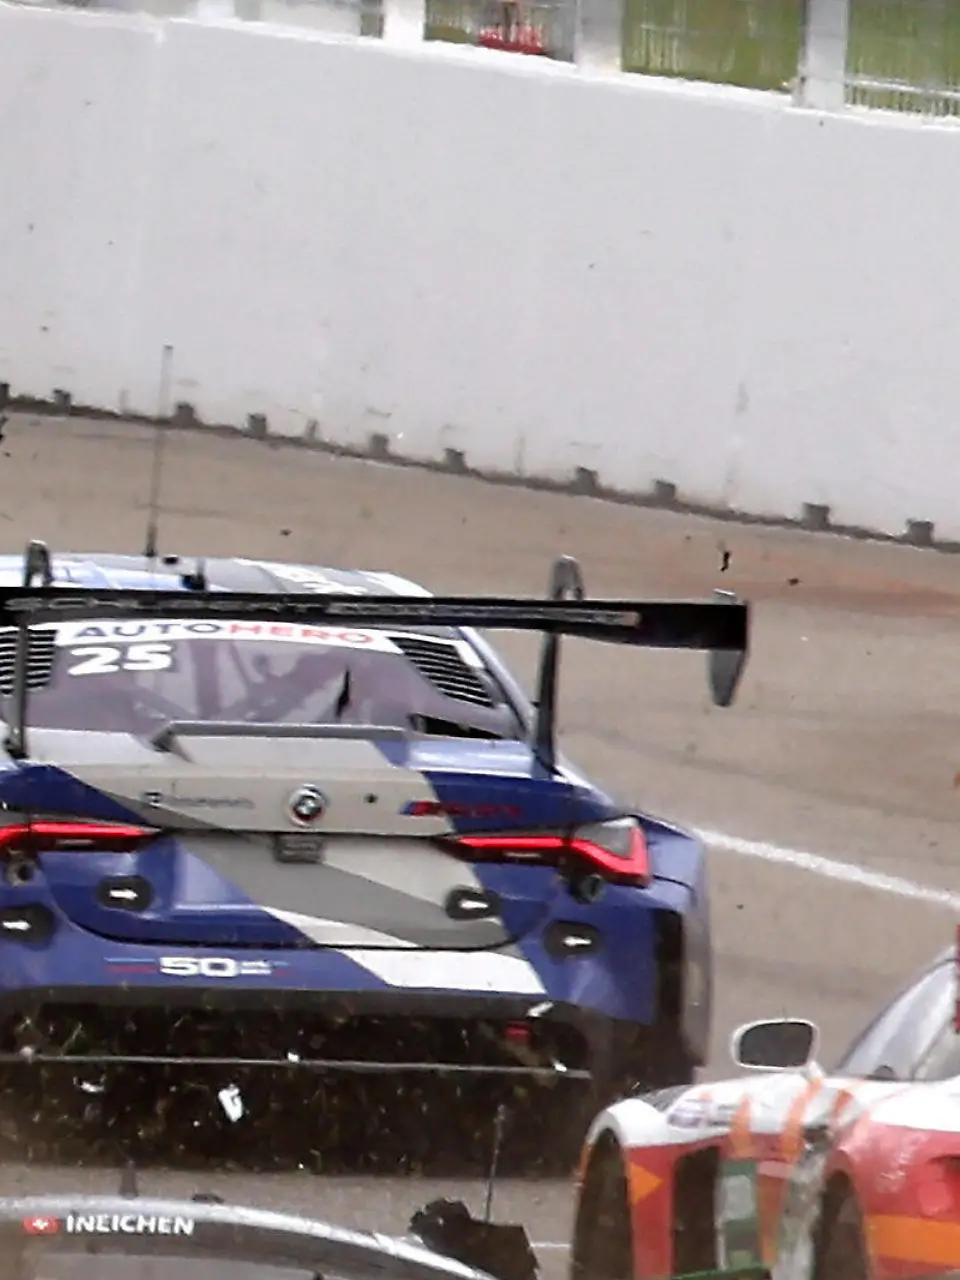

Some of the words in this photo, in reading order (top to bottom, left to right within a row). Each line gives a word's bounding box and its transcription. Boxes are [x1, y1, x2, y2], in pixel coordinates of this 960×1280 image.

[74, 622, 374, 644] AUTOHERO
[68, 644, 172, 676] 25
[159, 957, 237, 977] 50
[66, 1214, 194, 1236] INEICHEN
